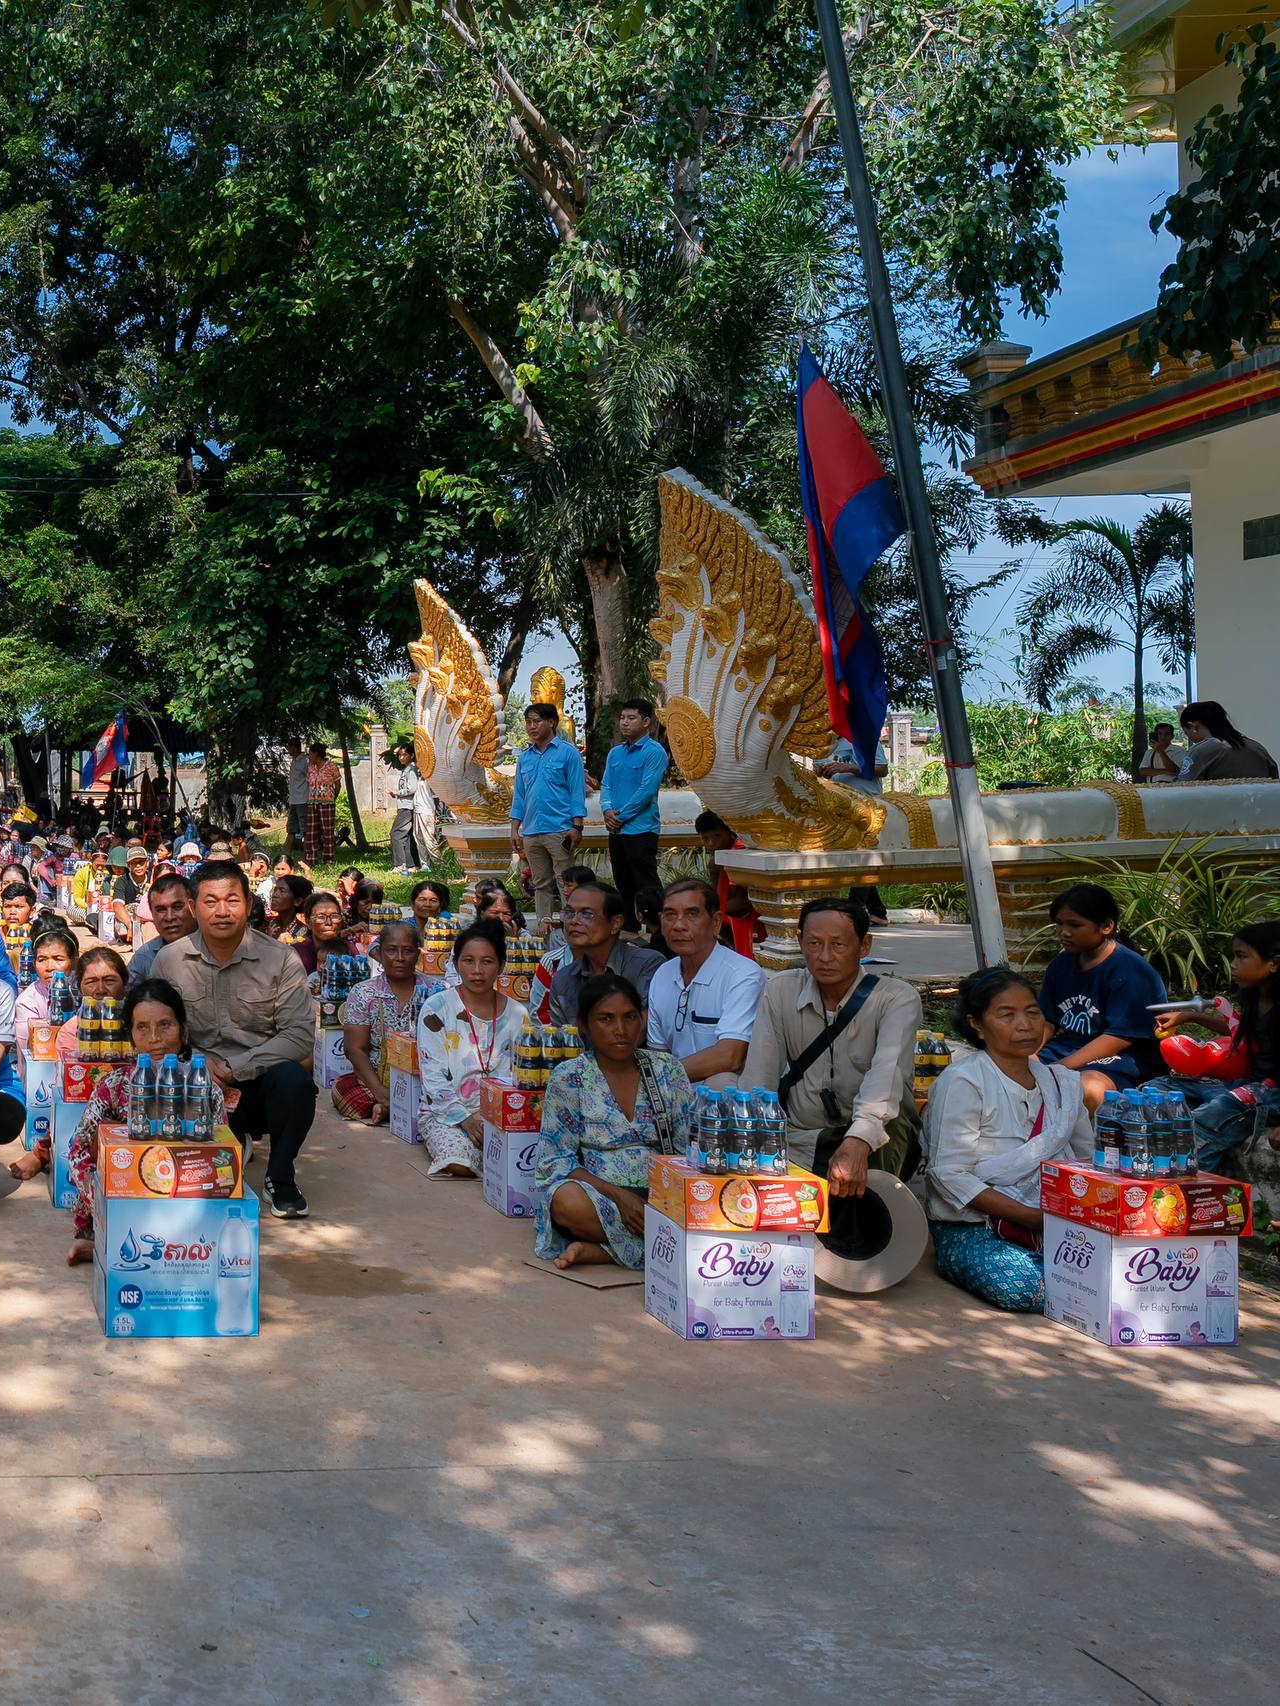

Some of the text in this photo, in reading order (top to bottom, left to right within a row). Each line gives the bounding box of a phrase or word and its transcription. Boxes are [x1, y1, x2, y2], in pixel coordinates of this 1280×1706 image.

[35, 1120, 48, 1130] NSF
[140, 1233, 213, 1261] វីតាល់
[747, 1244, 768, 1255] Vital
[1174, 1248, 1194, 1259] Vital
[227, 1255, 251, 1266] Vital
[697, 1242, 775, 1287] Baby
[783, 1264, 808, 1278] Baby
[1125, 1247, 1201, 1292] Baby
[120, 1290, 140, 1304] NSF
[713, 1297, 773, 1309] for Baby Formula
[1139, 1302, 1199, 1313] for Baby Formula
[694, 1326, 707, 1334] NSF
[1120, 1331, 1133, 1340] NSF
